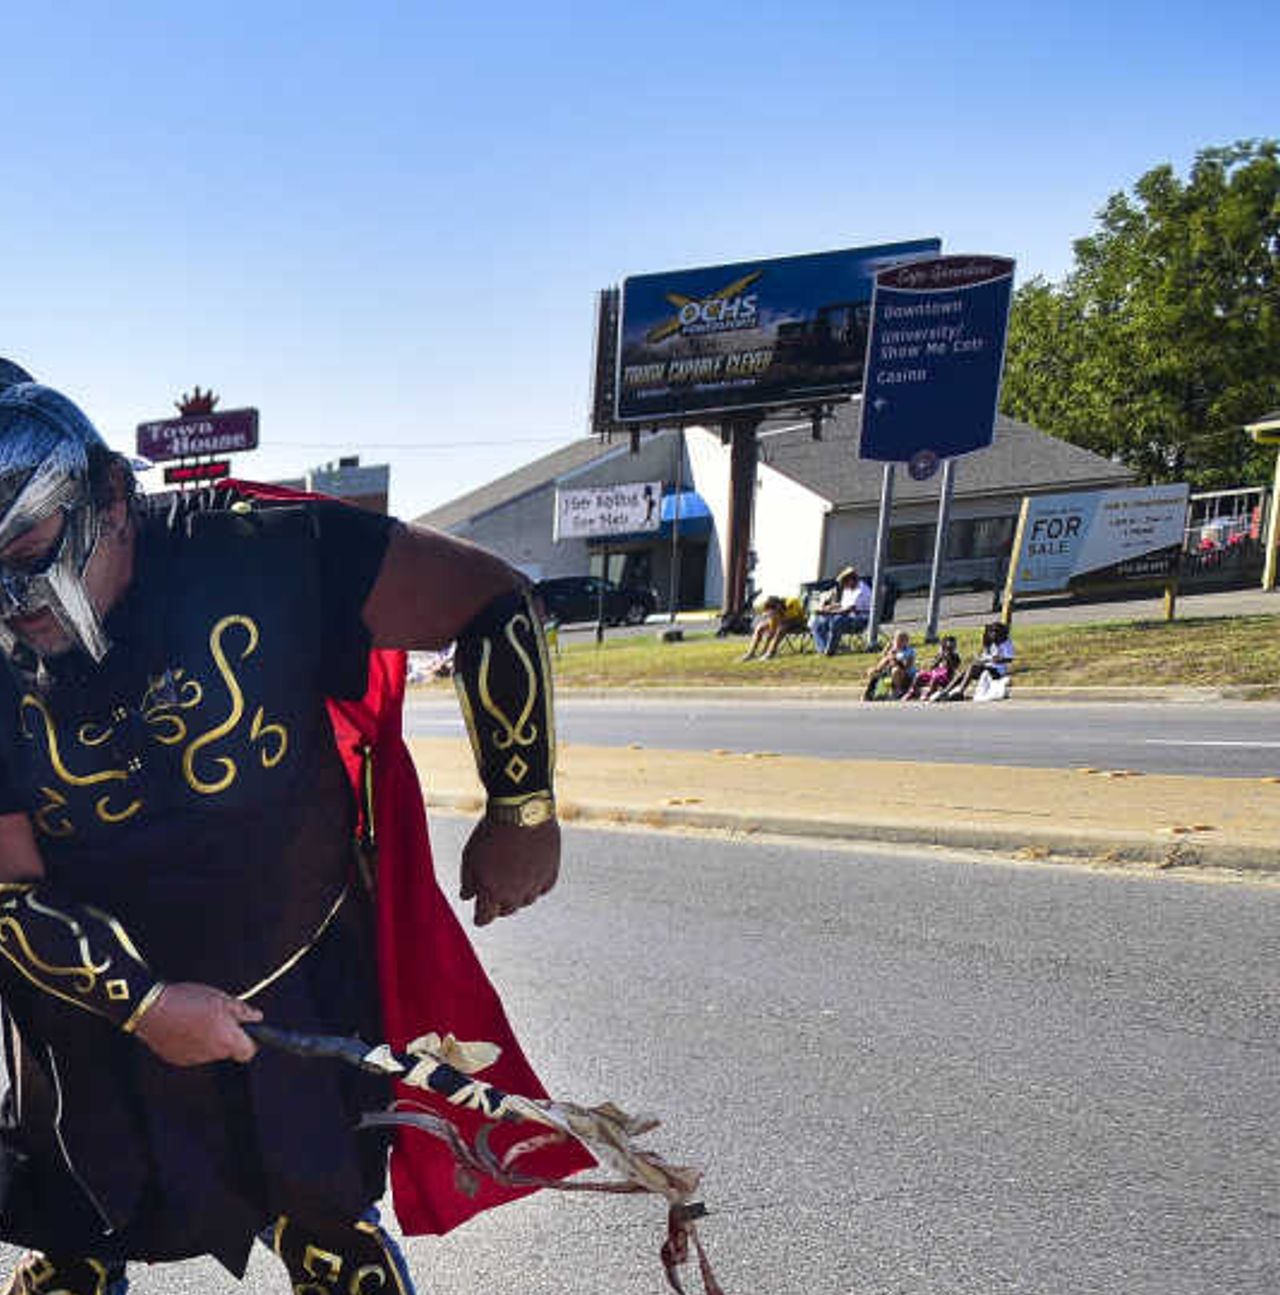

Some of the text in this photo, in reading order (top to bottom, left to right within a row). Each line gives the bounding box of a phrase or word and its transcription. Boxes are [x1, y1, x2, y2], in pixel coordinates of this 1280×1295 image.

[679, 295, 757, 325] OCHS
[884, 299, 962, 319] Downtown
[881, 345, 917, 361] Show
[926, 342, 947, 355] Me
[876, 369, 927, 384] Casino
[148, 422, 215, 442] Town
[169, 433, 246, 455] House
[1030, 515, 1083, 541] FOR
[1027, 540, 1071, 557] SALE
